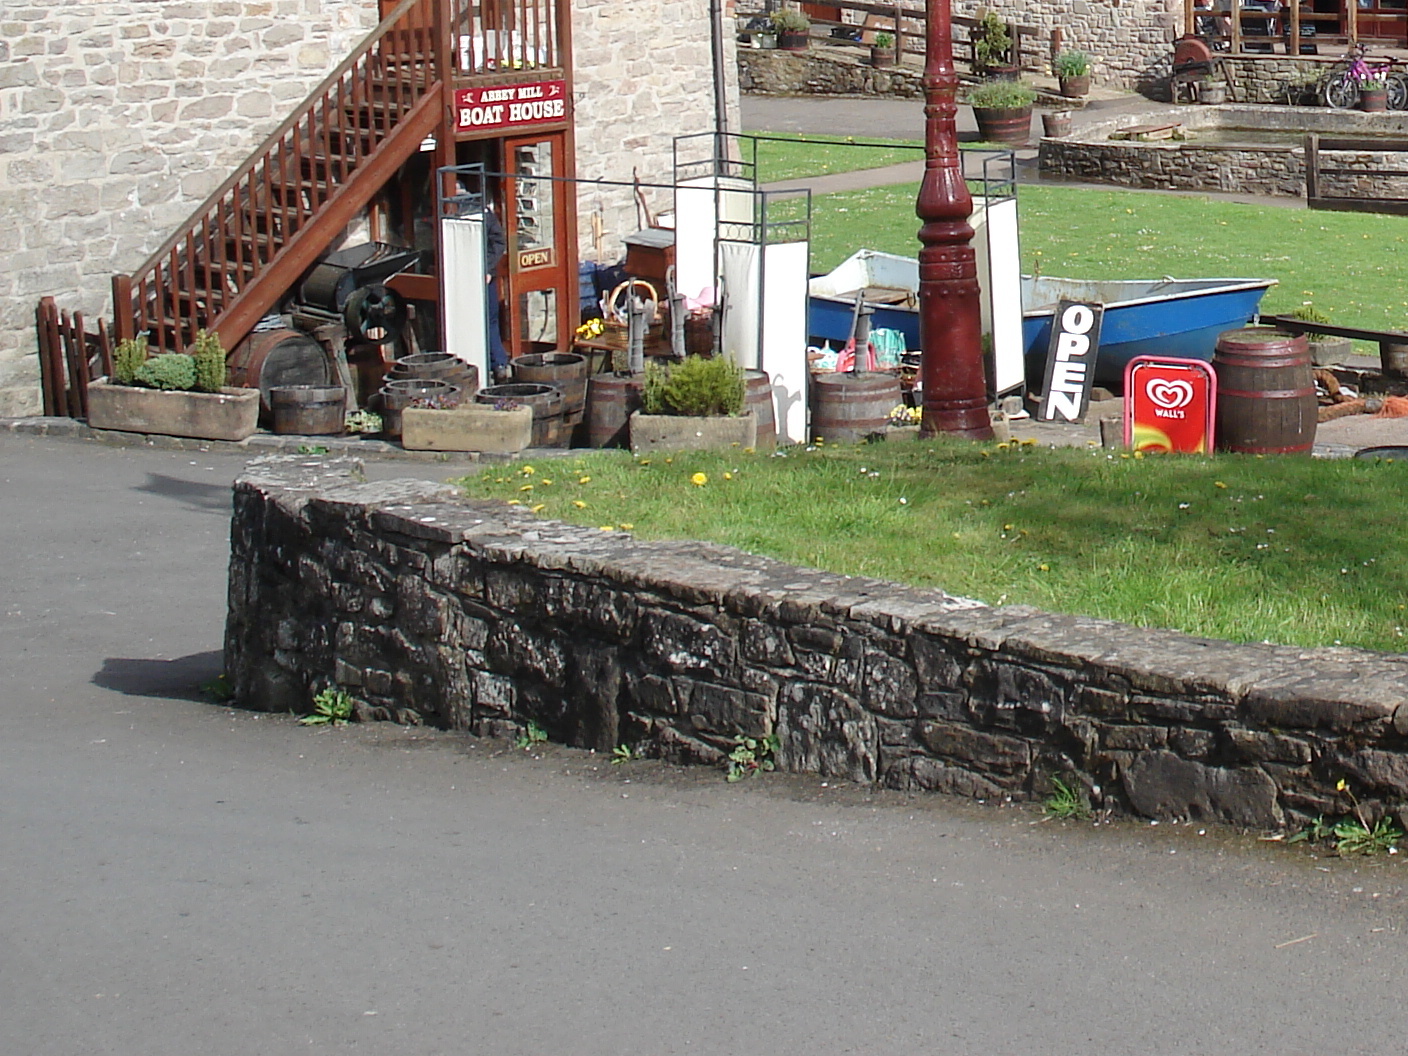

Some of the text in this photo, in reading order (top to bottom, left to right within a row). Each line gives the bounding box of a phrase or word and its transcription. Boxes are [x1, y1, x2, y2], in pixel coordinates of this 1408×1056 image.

[480, 86, 544, 103] ABBEY MILL
[459, 99, 565, 127] BOAT HOUSE
[521, 251, 549, 267] OPEN
[1045, 304, 1095, 422] OPEN
[1154, 408, 1186, 419] WALL'S
